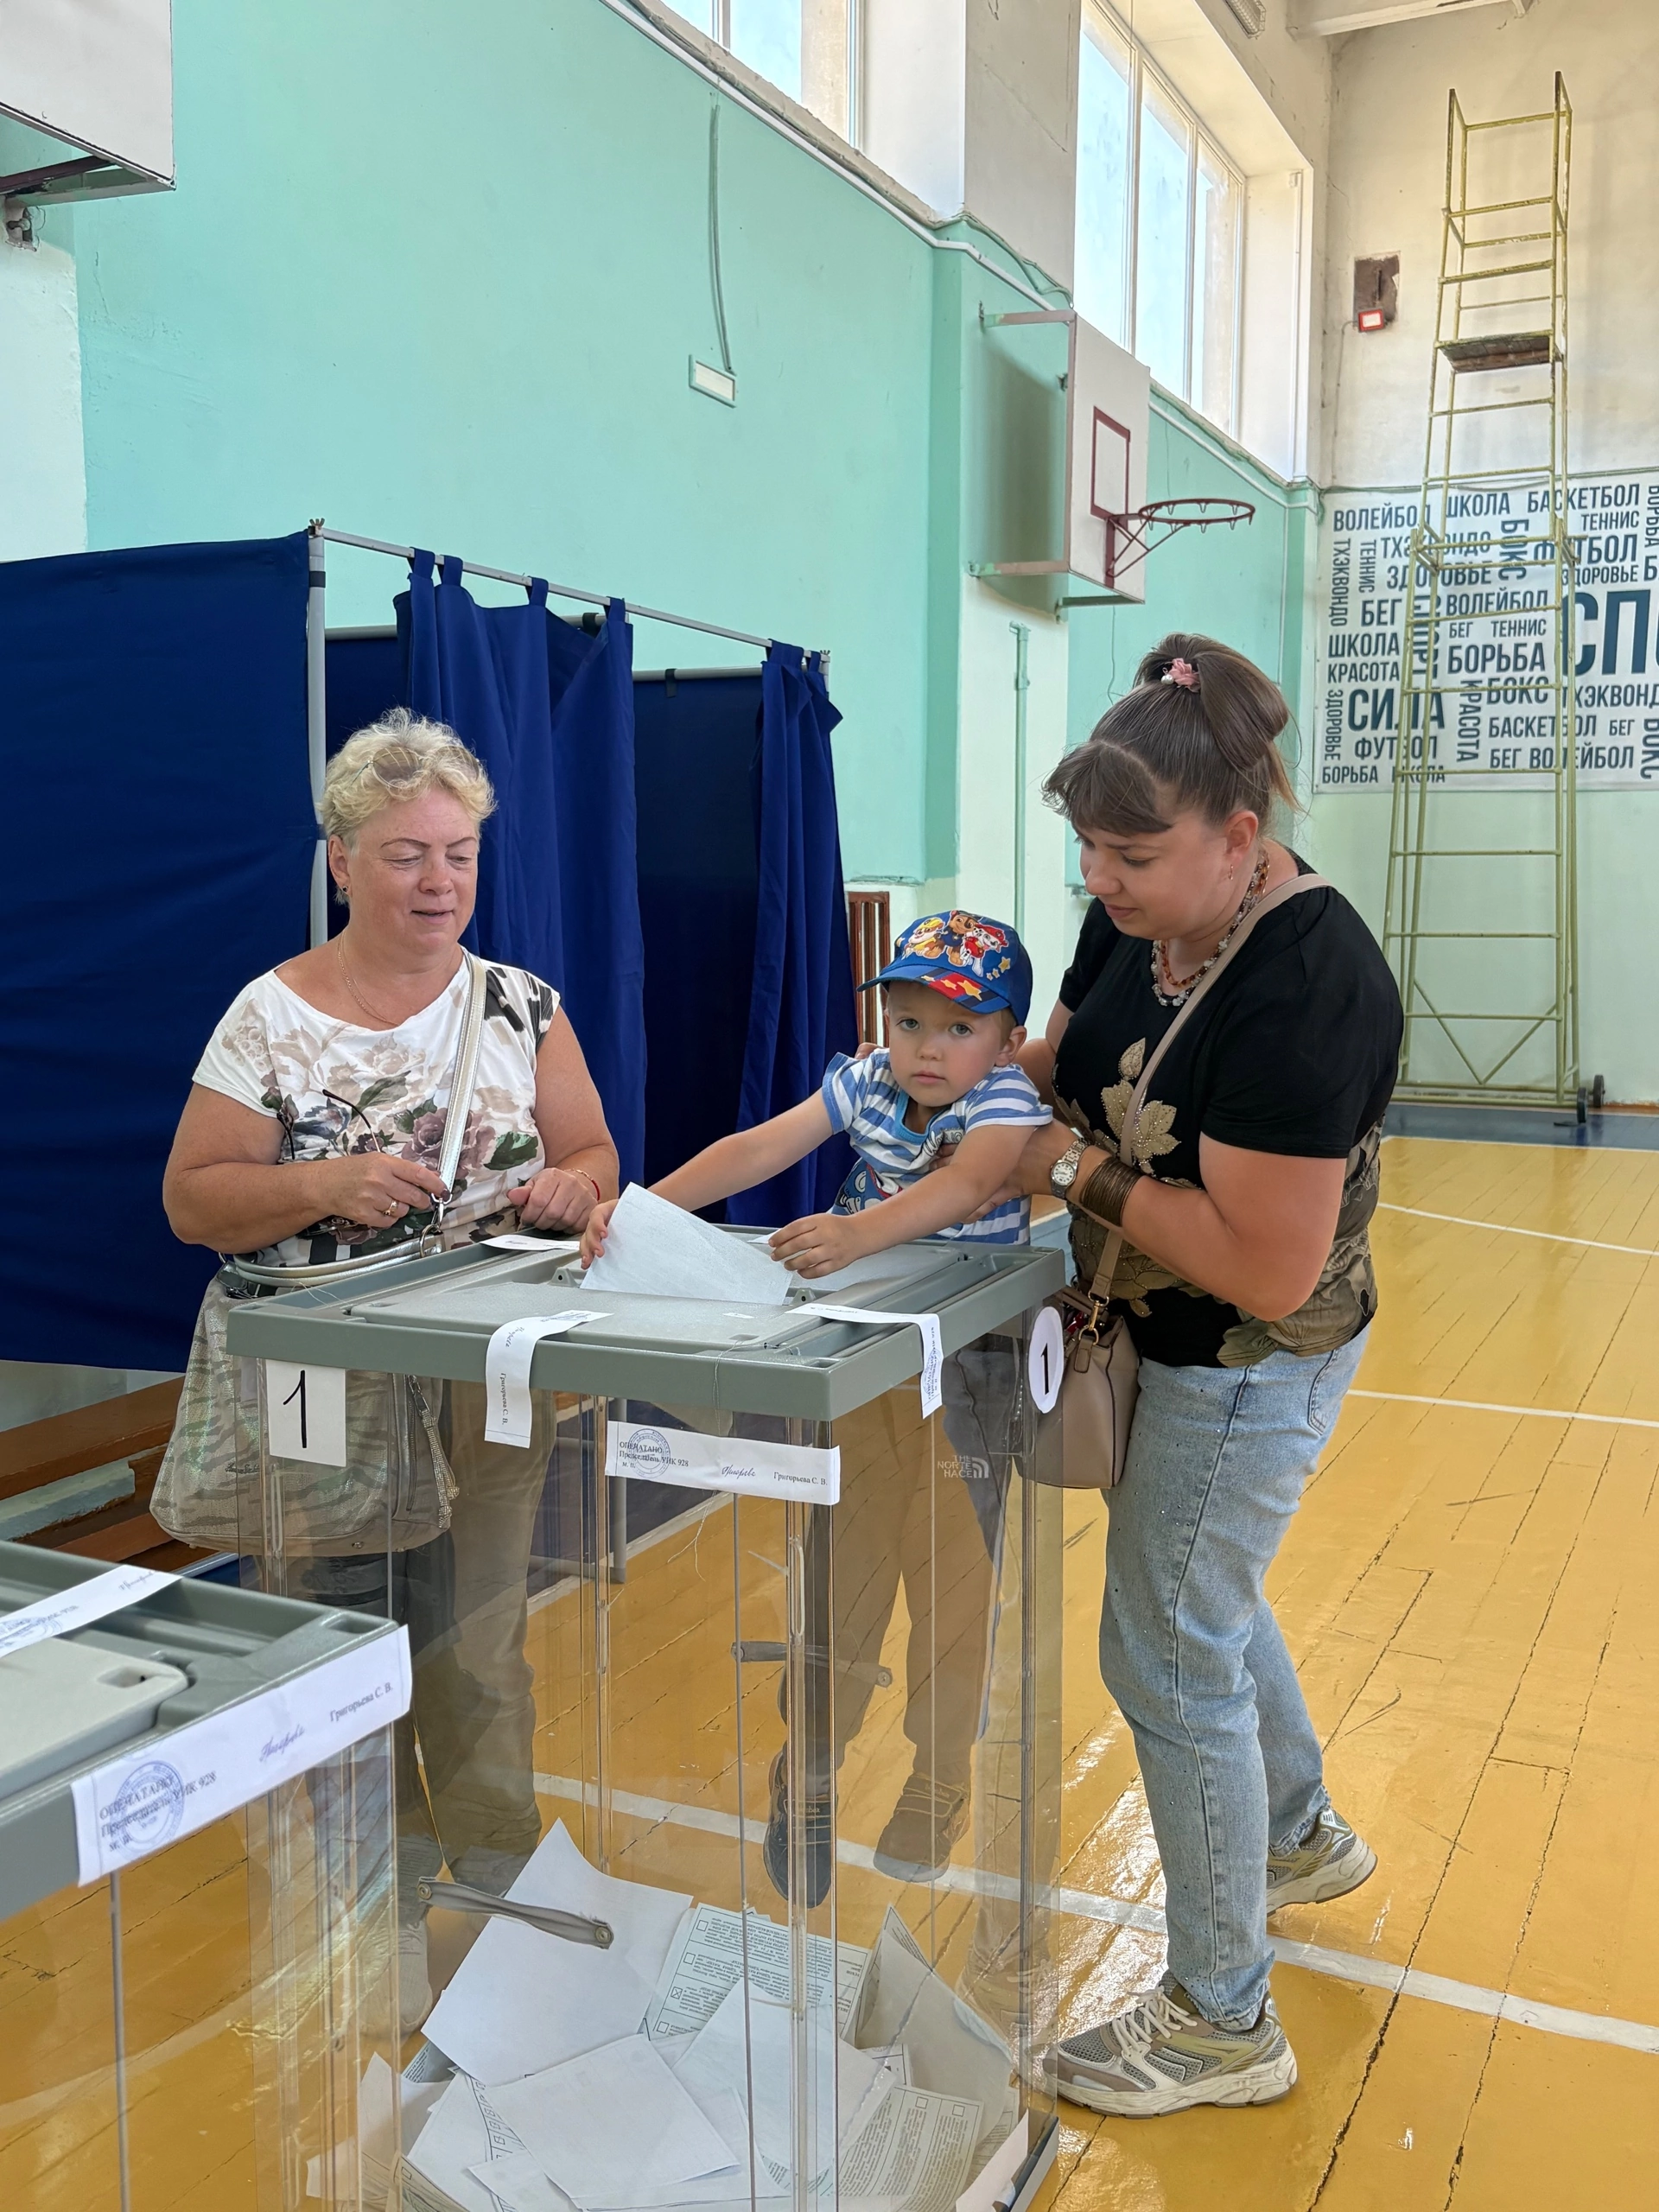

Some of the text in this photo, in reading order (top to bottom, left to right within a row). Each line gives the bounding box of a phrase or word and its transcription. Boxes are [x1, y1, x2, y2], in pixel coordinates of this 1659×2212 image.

[1446, 493, 1510, 518] ШКОЛА
[1527, 483, 1640, 513] БАСКЕТБОЛ
[1581, 511, 1640, 531] ТЕННИС
[1381, 531, 1491, 559] ТХЭОНДО
[1498, 519, 1529, 581] БОКС
[1534, 534, 1637, 567] ФТБОЛ
[1358, 539, 1376, 593] ТЕННИС
[1387, 561, 1492, 591] ЗДООВЬЕ
[1329, 538, 1351, 626] ТХЭКВОНДО
[1361, 598, 1402, 626] БЕГ
[1446, 587, 1548, 616] ВОЛЕЙБОЛ
[1449, 622, 1473, 639] БЕГ
[1491, 619, 1548, 639] ТЕННИС
[1554, 589, 1659, 677] СП
[1328, 632, 1400, 658] ШКОЛА
[1447, 642, 1546, 674] БОРЬБА
[1328, 662, 1400, 683] КРАСОТА
[1487, 676, 1549, 705] БОКС
[1348, 688, 1445, 731] СИЛА
[1456, 680, 1483, 762] КРАСОТА
[1325, 690, 1343, 760] ЗДОРОВЬЕ
[1609, 719, 1635, 736] БЕГ
[1354, 735, 1437, 760] ФУТОЛ
[1490, 748, 1522, 768] БЕГ
[1322, 766, 1378, 784] БОРЬБА
[1040, 1343, 1049, 1395] 1
[283, 1370, 307, 1449] 1
[677, 1459, 689, 1467] 928
[773, 1471, 810, 1483] Григорьева
[330, 1694, 374, 1722] Григорьева
[198, 1770, 217, 1789] 928
